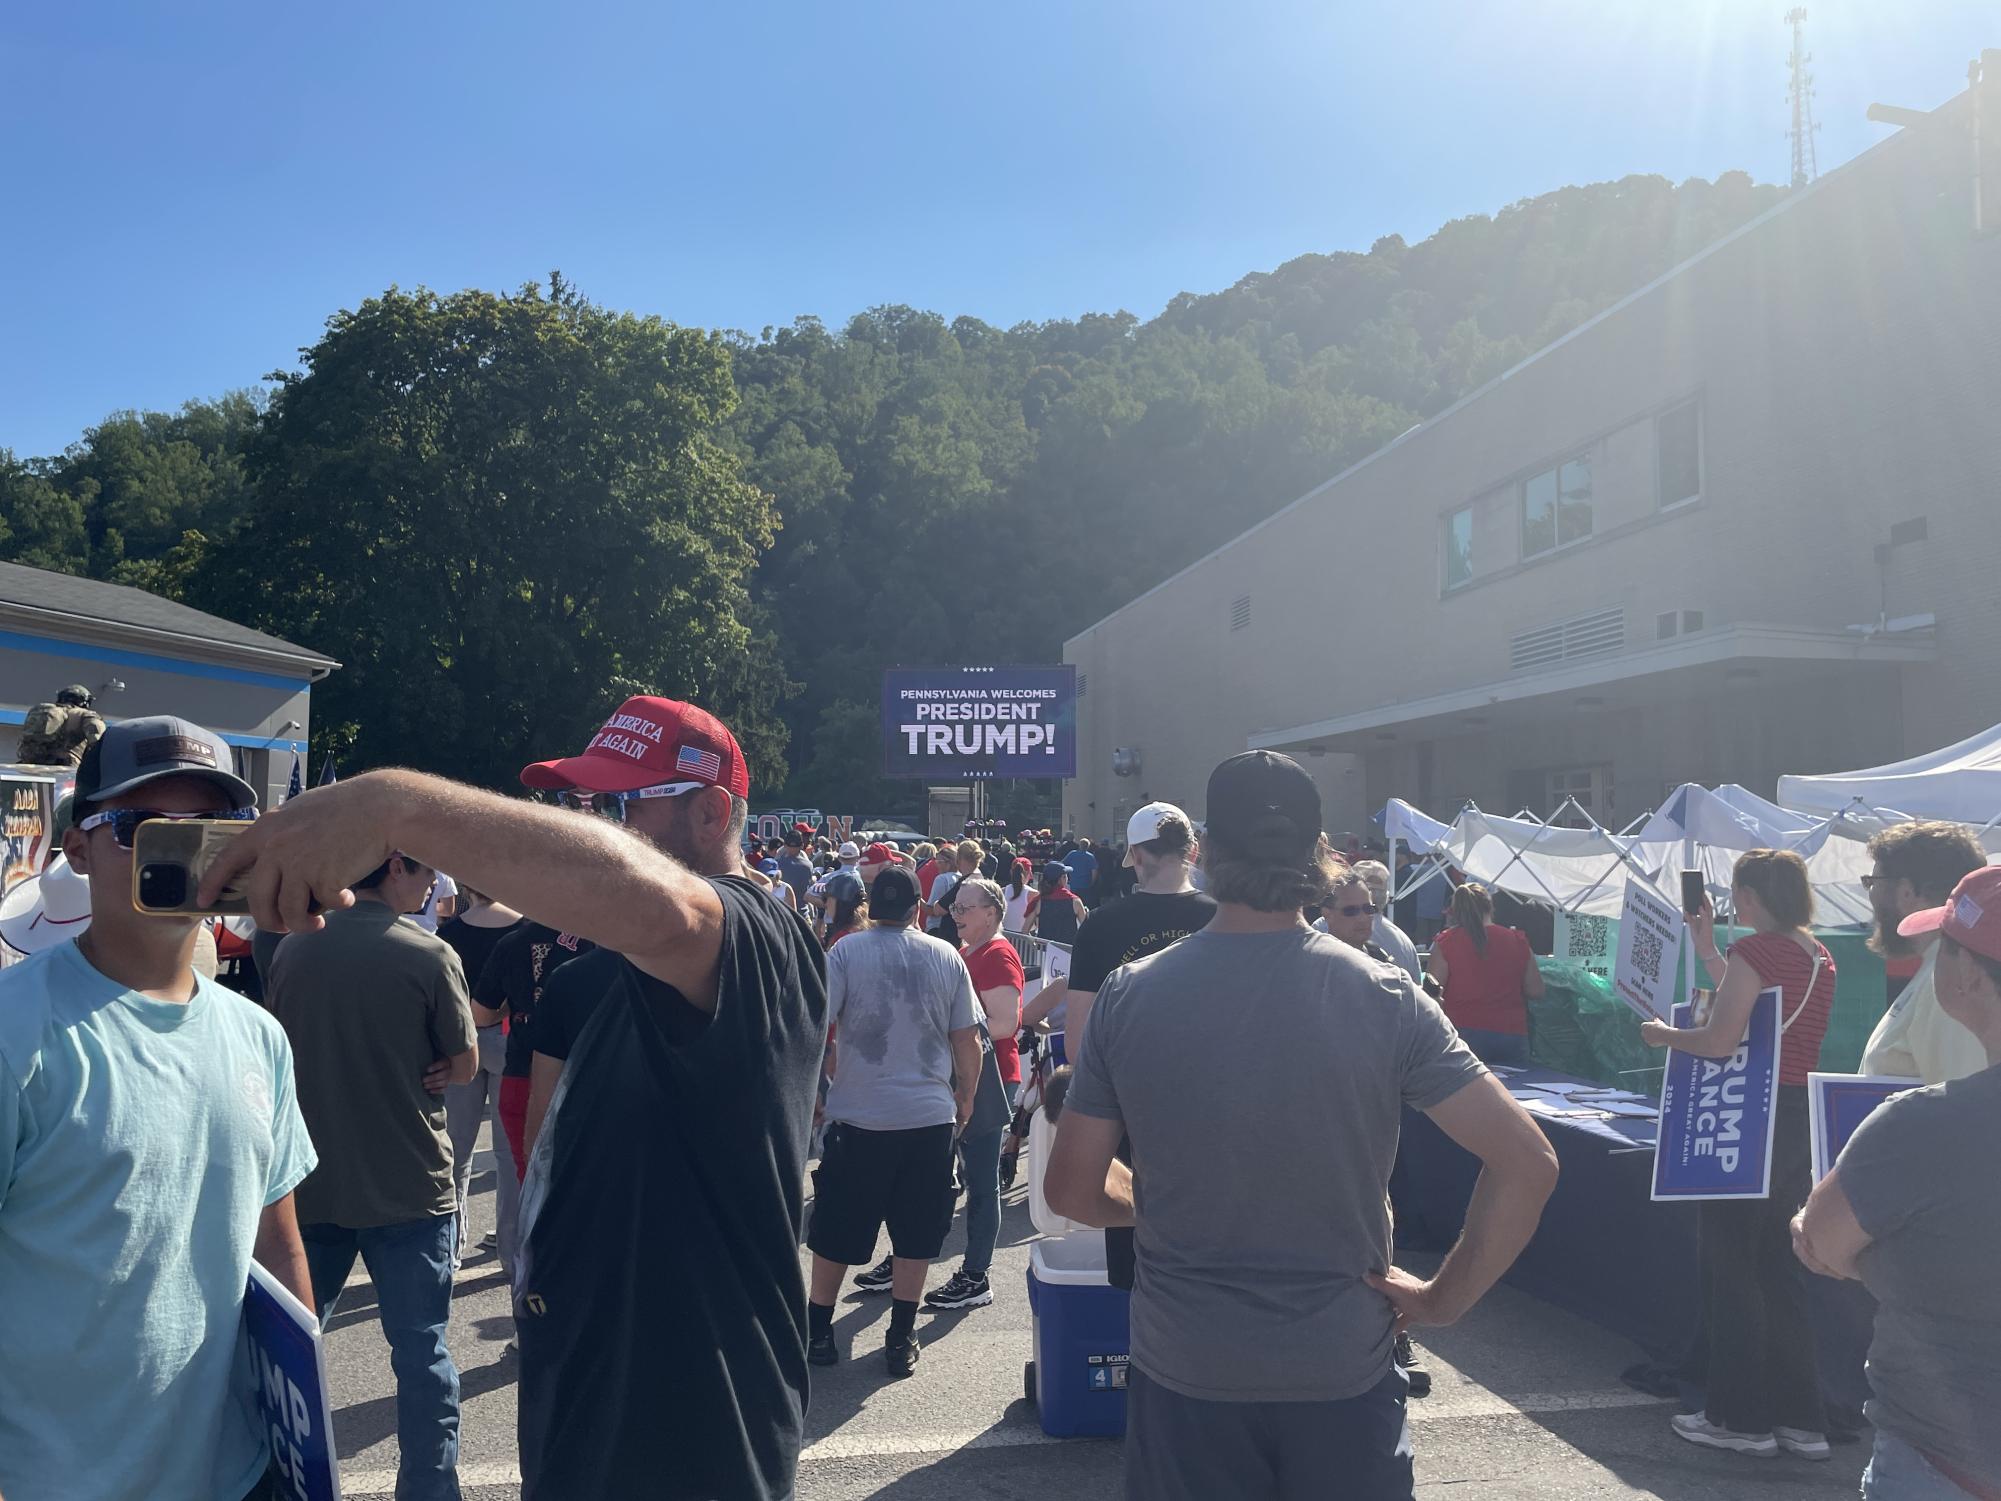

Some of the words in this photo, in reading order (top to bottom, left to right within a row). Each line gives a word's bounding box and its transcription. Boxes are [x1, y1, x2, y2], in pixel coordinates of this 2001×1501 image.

[900, 690, 988, 699] PENNSYLVANIA
[991, 689, 1057, 698] WELCOMES
[916, 703, 1041, 720] PRESIDENT
[606, 713, 663, 743] AMERICA
[900, 724, 1055, 755] TRUMP!
[598, 733, 649, 760] AGAIN
[1647, 901, 1671, 925] WORKERS
[1140, 932, 1158, 945] OR
[1688, 1058, 1699, 1099] AMERICA
[1664, 1085, 1674, 1113] 2024
[1685, 1101, 1694, 1132] GREAT
[1681, 1133, 1690, 1167] AGAIN!
